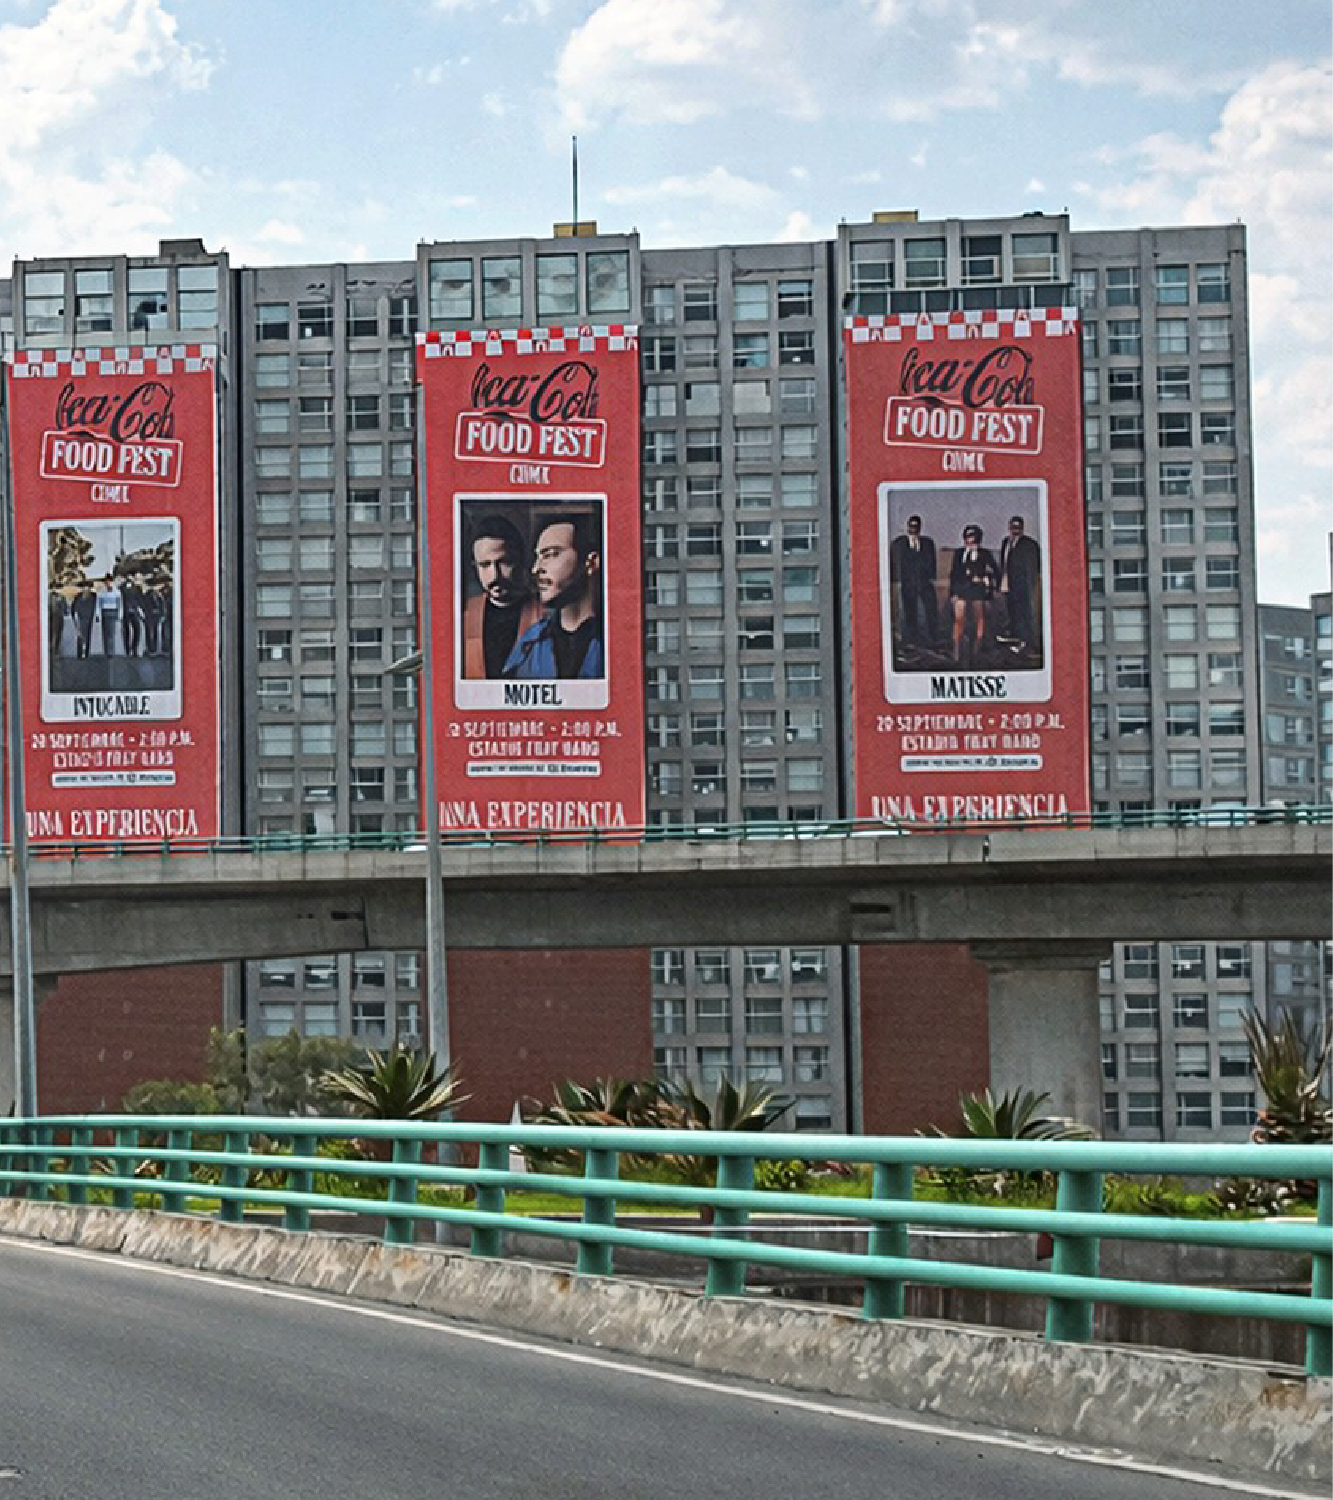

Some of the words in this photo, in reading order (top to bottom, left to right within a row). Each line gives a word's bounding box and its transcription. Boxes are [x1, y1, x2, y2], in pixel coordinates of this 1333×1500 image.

[466, 420, 533, 453] FOOD
[539, 425, 598, 457] FEST
[896, 406, 965, 440] FOOD
[972, 411, 1033, 445] FEST
[52, 439, 113, 473] FOOD
[118, 444, 174, 476] FEST
[504, 683, 563, 706] MOTEL
[488, 801, 627, 829] EXPERIENCIA
